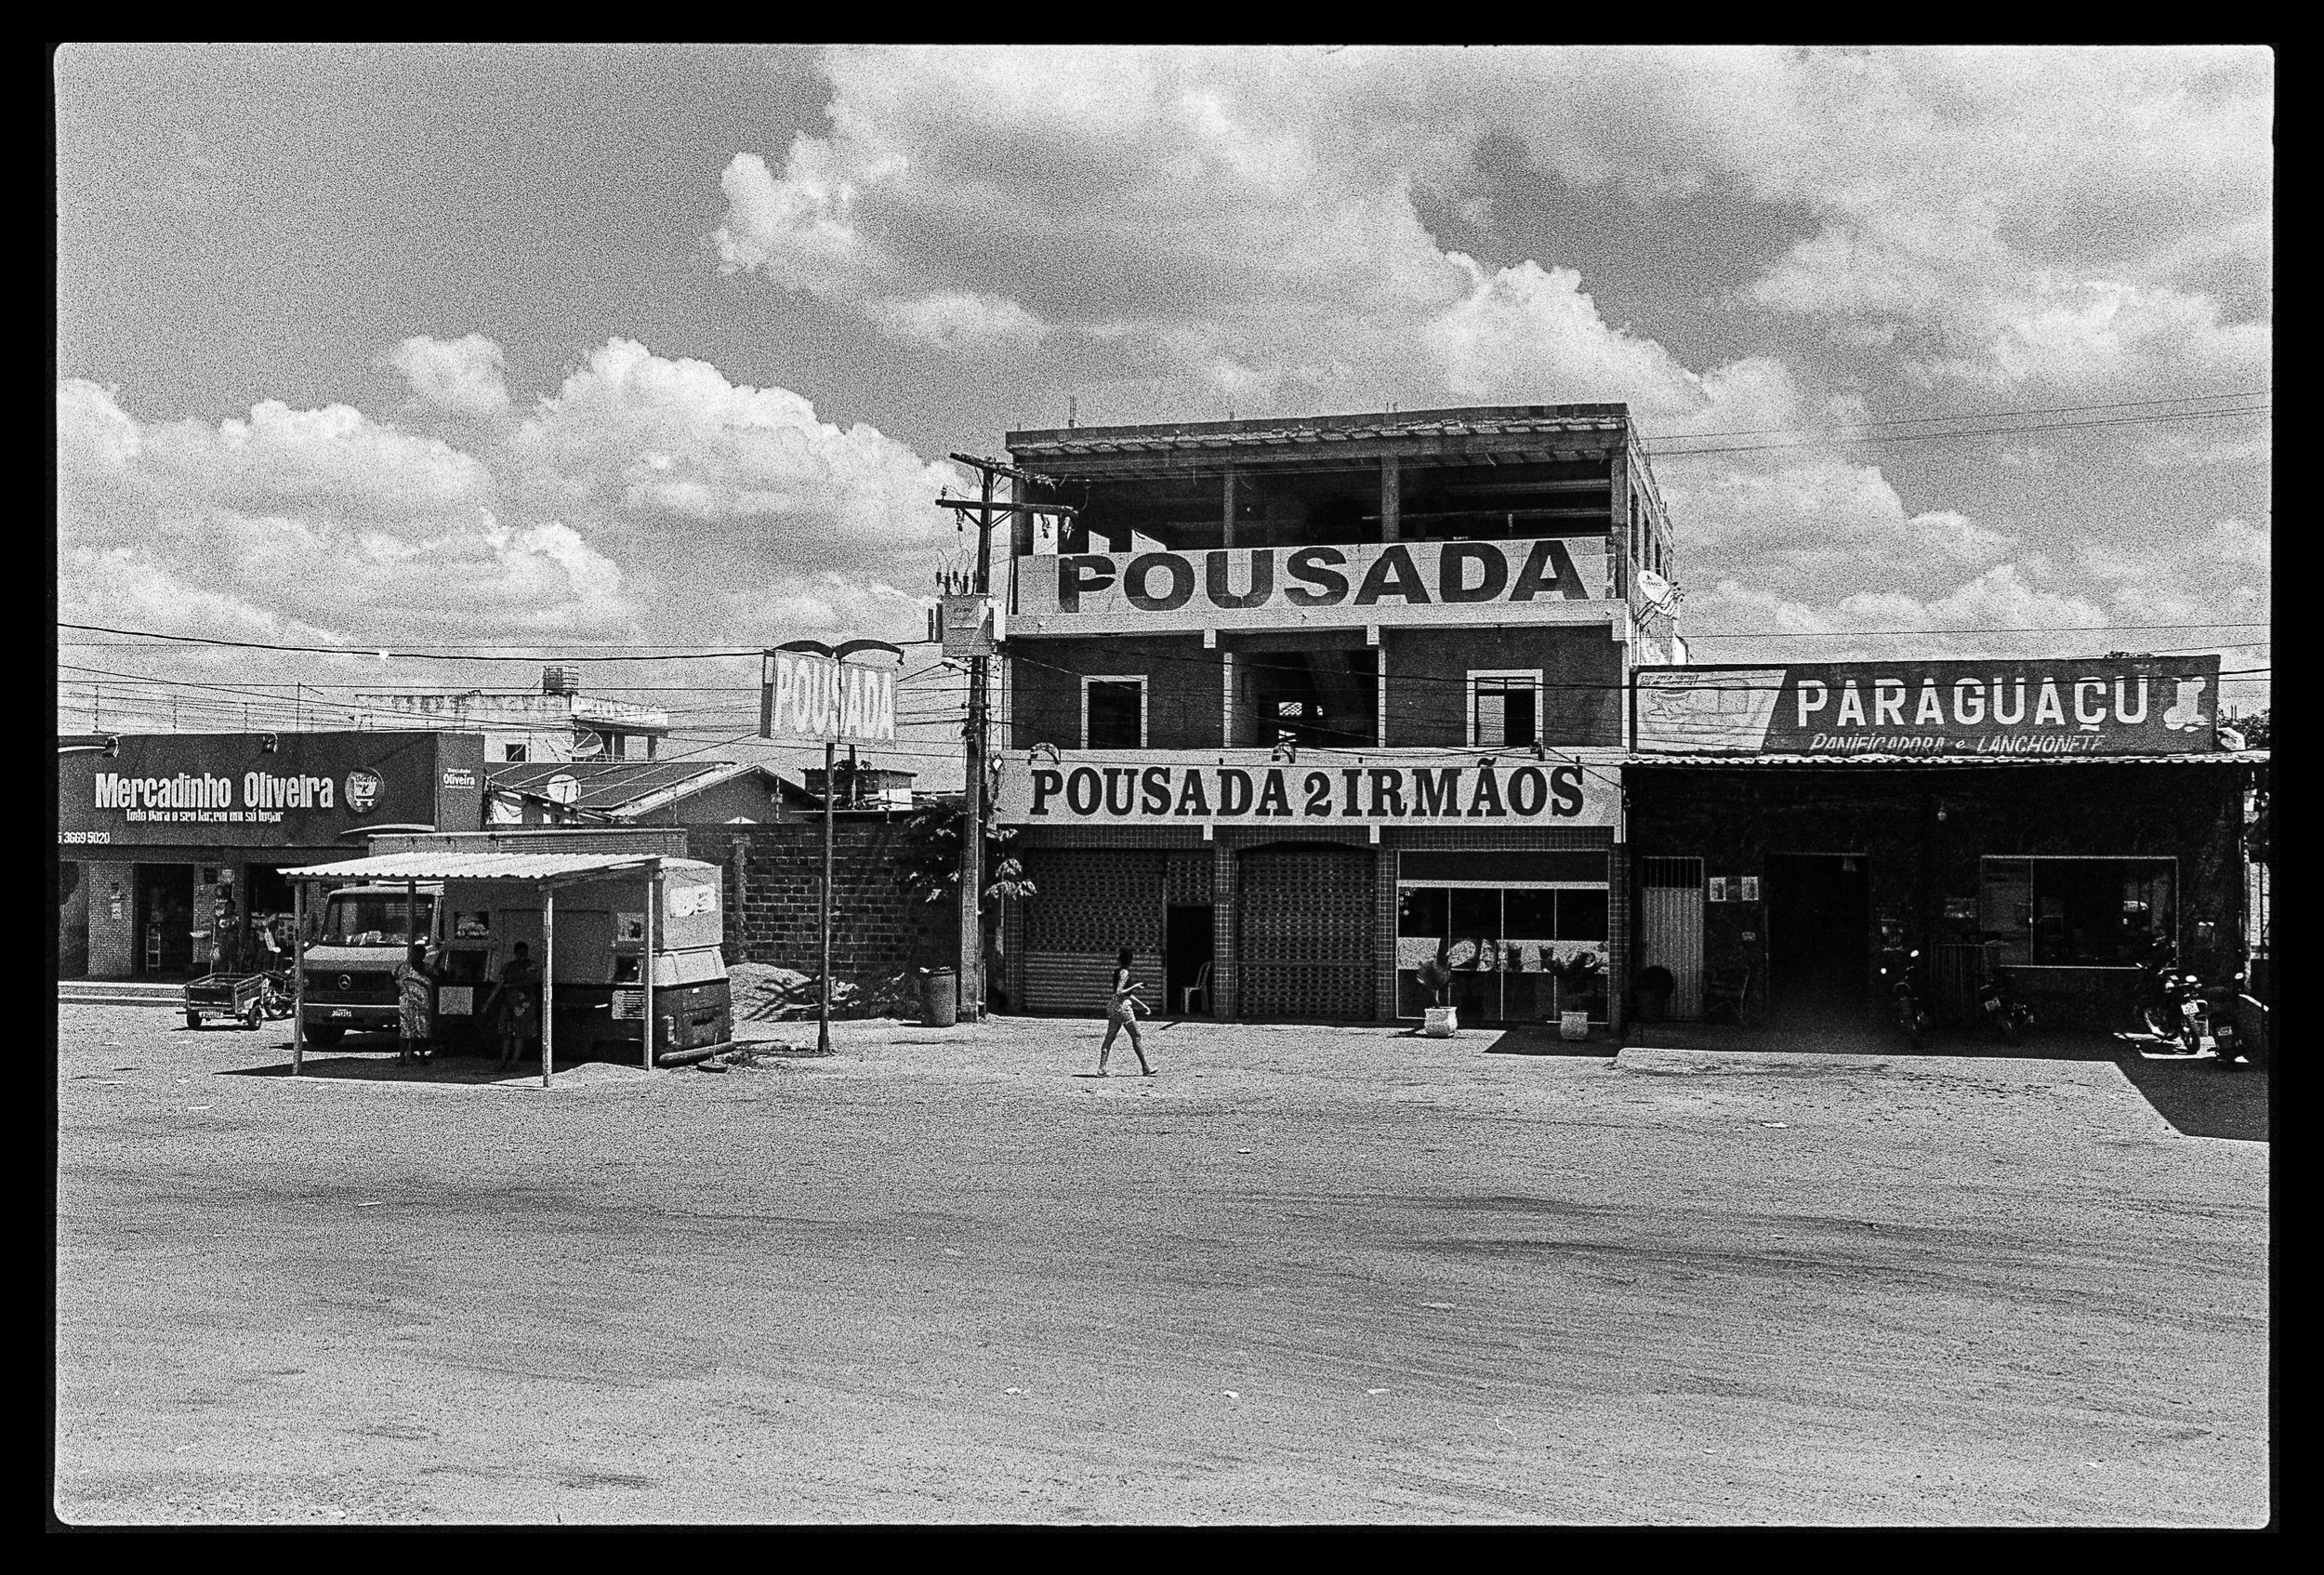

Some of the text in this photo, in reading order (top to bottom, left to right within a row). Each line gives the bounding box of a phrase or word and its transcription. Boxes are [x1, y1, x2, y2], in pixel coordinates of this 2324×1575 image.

[1058, 540, 1590, 613] POUSADA
[773, 656, 895, 741] POUSADA
[1798, 675, 2148, 732] PARAGUAÇU
[1809, 733, 1945, 753] PANIFICADORA
[1955, 739, 1966, 749] e
[96, 772, 334, 808] Mercadinho Oliveira
[442, 773, 475, 786] Oliveira
[1029, 757, 1584, 816] POUSADA 2 IRMÃOS
[149, 810, 170, 822] para
[172, 811, 178, 822] o
[179, 811, 196, 822] seu
[230, 811, 244, 822] um
[245, 808, 257, 822] só
[258, 809, 284, 824] lugar
[64, 831, 86, 844] 3669
[87, 831, 111, 844] 5020
